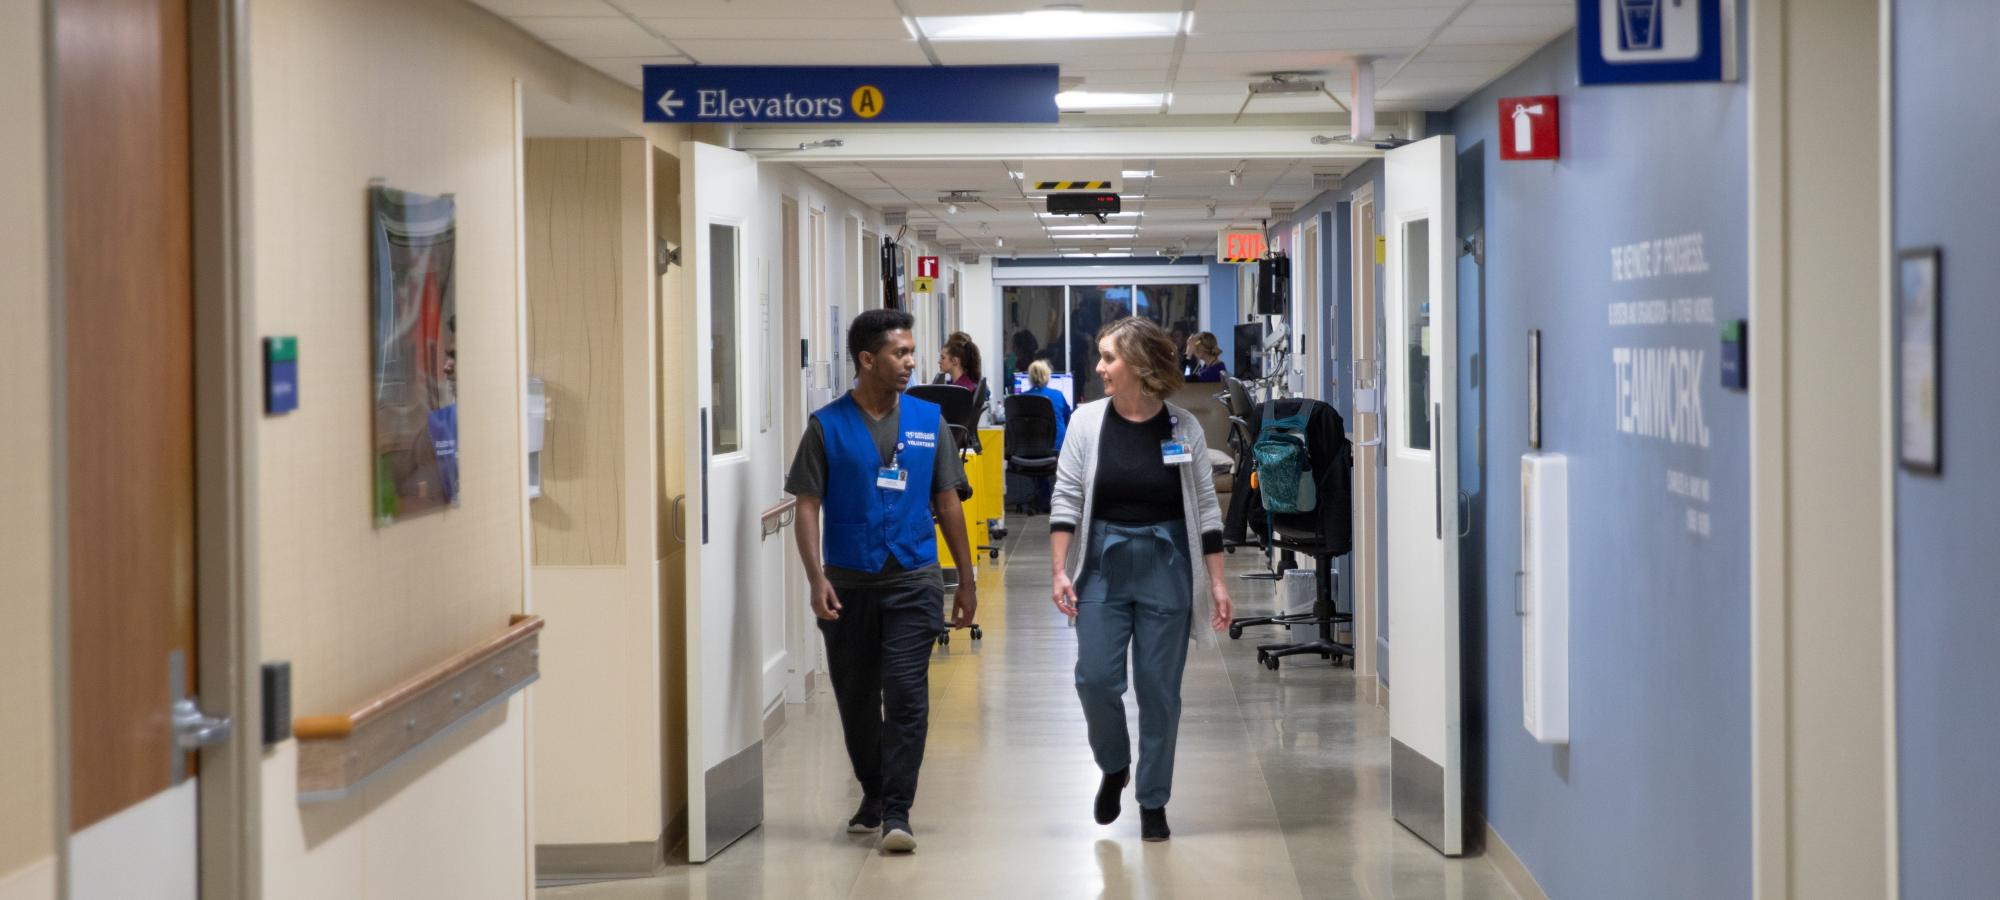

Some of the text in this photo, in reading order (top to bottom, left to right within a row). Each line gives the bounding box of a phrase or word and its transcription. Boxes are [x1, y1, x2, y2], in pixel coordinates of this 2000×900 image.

[697, 89, 876, 117] Elevators A
[1228, 233, 1264, 258] EXIT
[1613, 346, 1710, 448] TEAMWORK.
